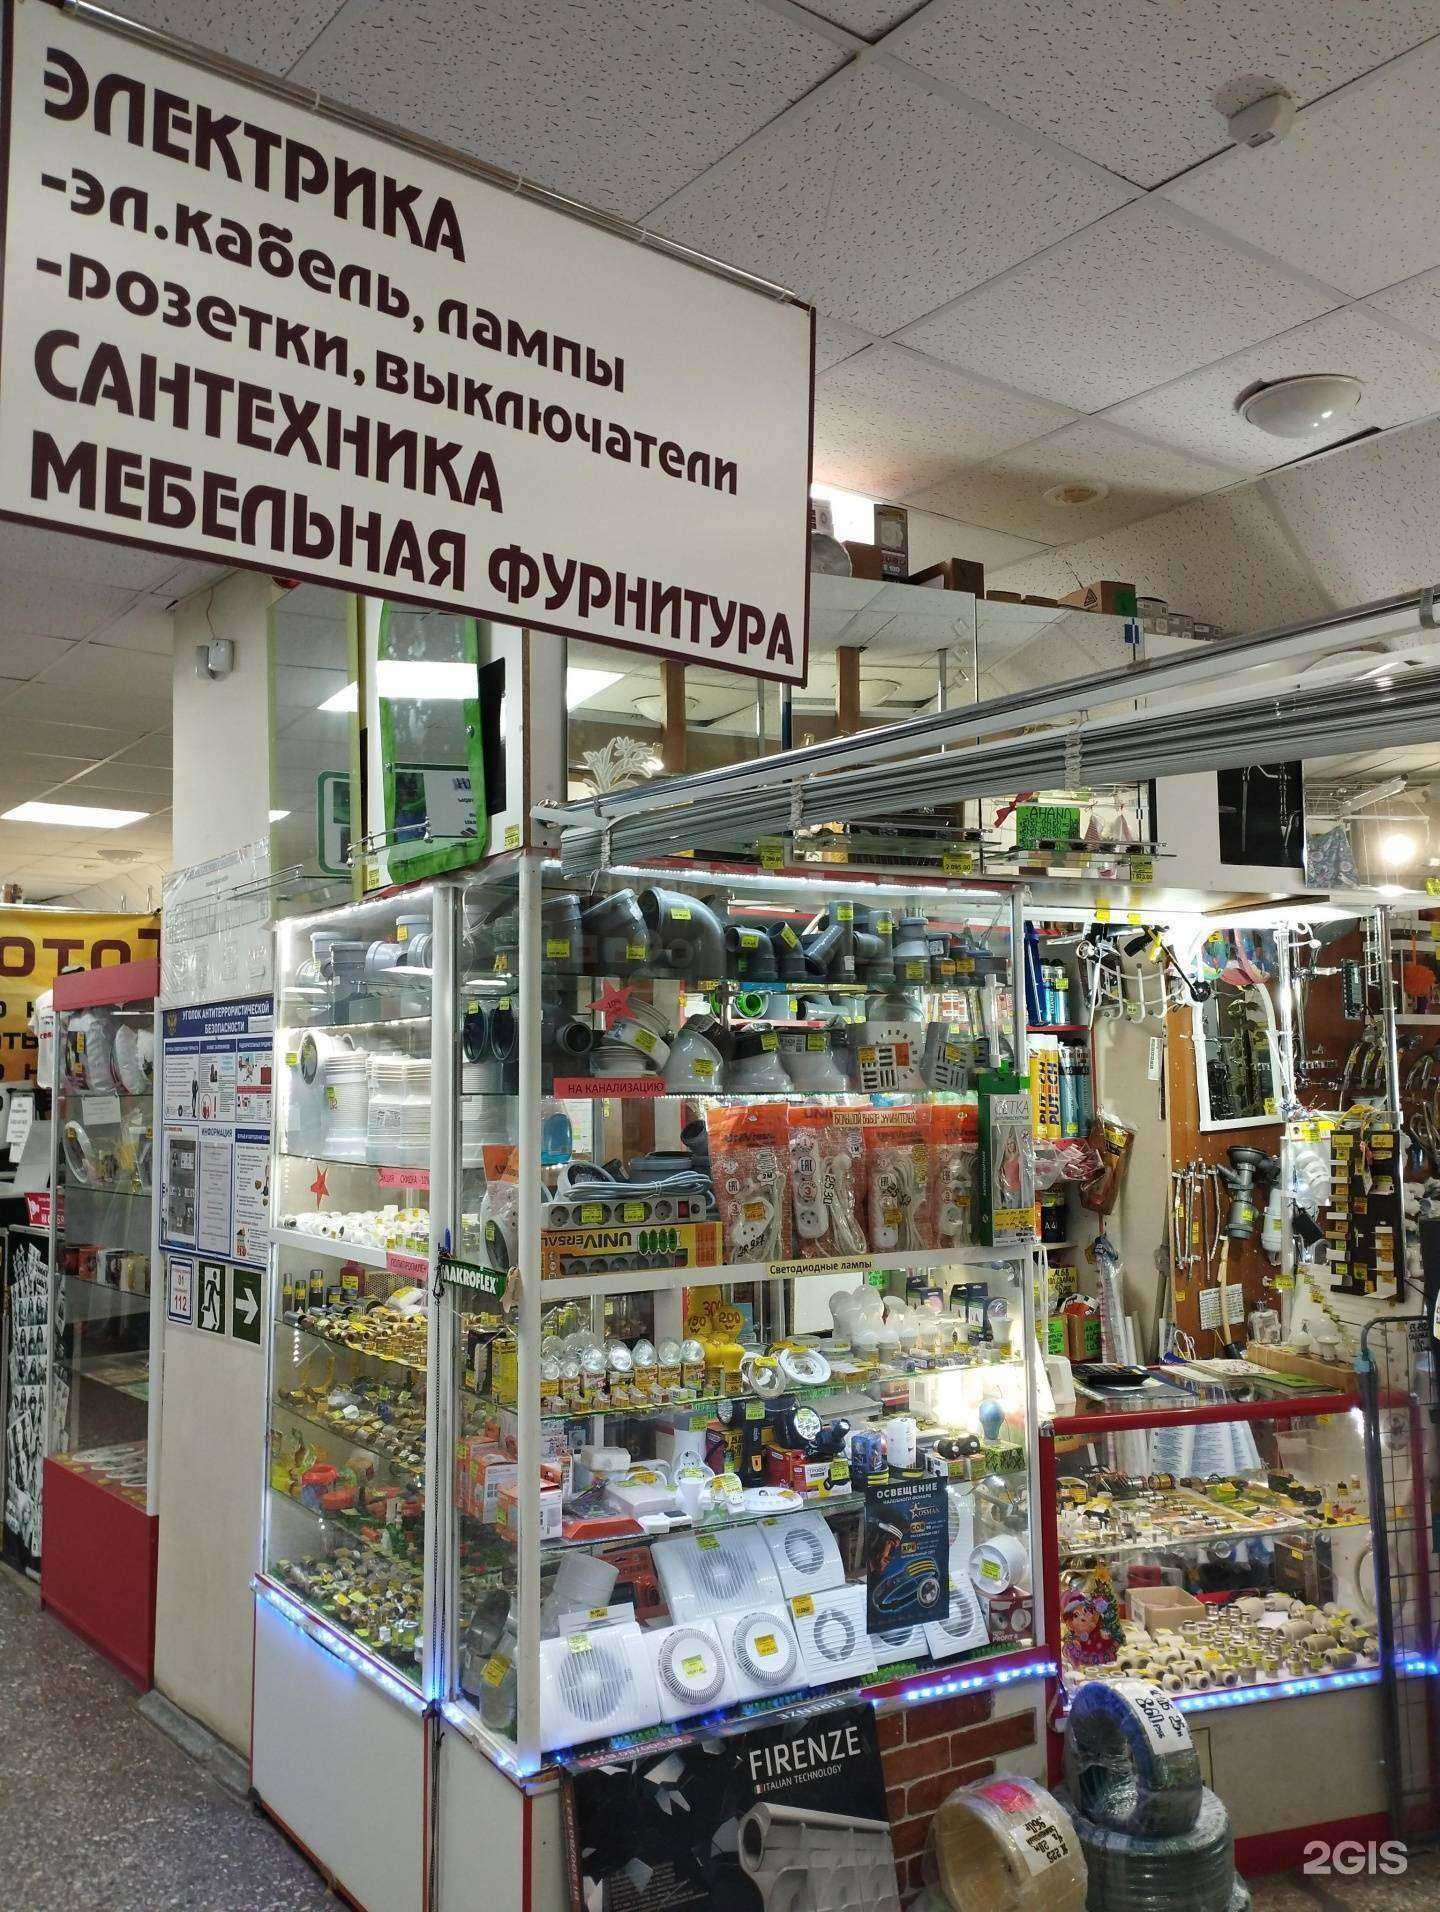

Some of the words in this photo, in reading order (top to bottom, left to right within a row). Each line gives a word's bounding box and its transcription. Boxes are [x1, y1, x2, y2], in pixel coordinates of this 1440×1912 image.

[43, 47, 466, 263] ЭЛЕКТРИКА
[437, 298, 625, 395] лампы
[34, 329, 504, 514] САНТЕХНИКА
[31, 430, 467, 591] МЕБЕЛЬНАЯ
[488, 543, 795, 665] ФУРНИТУРА
[182, 1010, 201, 1021] УГОЛОК
[201, 1001, 270, 1019] АНТИТЕРРОРИСТИЧЕСКОЙ
[204, 1021, 245, 1034] БЕЗОПАСНОСТИ
[568, 1084, 583, 1093] НА
[585, 1082, 664, 1094] КАНАЛИЗАЦИЮ
[1047, 1061, 1060, 1125] PUTECH
[202, 1128, 232, 1137] ИНФОРМАЦИЯ
[542, 1231, 632, 1249] UNIVERSAL
[770, 1263, 839, 1275] Светодиодные
[841, 1259, 872, 1270] лампы
[442, 1265, 496, 1295] MAKROFLEX
[175, 1295, 187, 1311] 112
[876, 1482, 938, 1499] ОСВЕЩЕНИЕ
[750, 1726, 861, 1781] FIRENZE
[763, 1777, 793, 1792] ITALIAN
[794, 1763, 842, 1785] TECHNOLOGY
